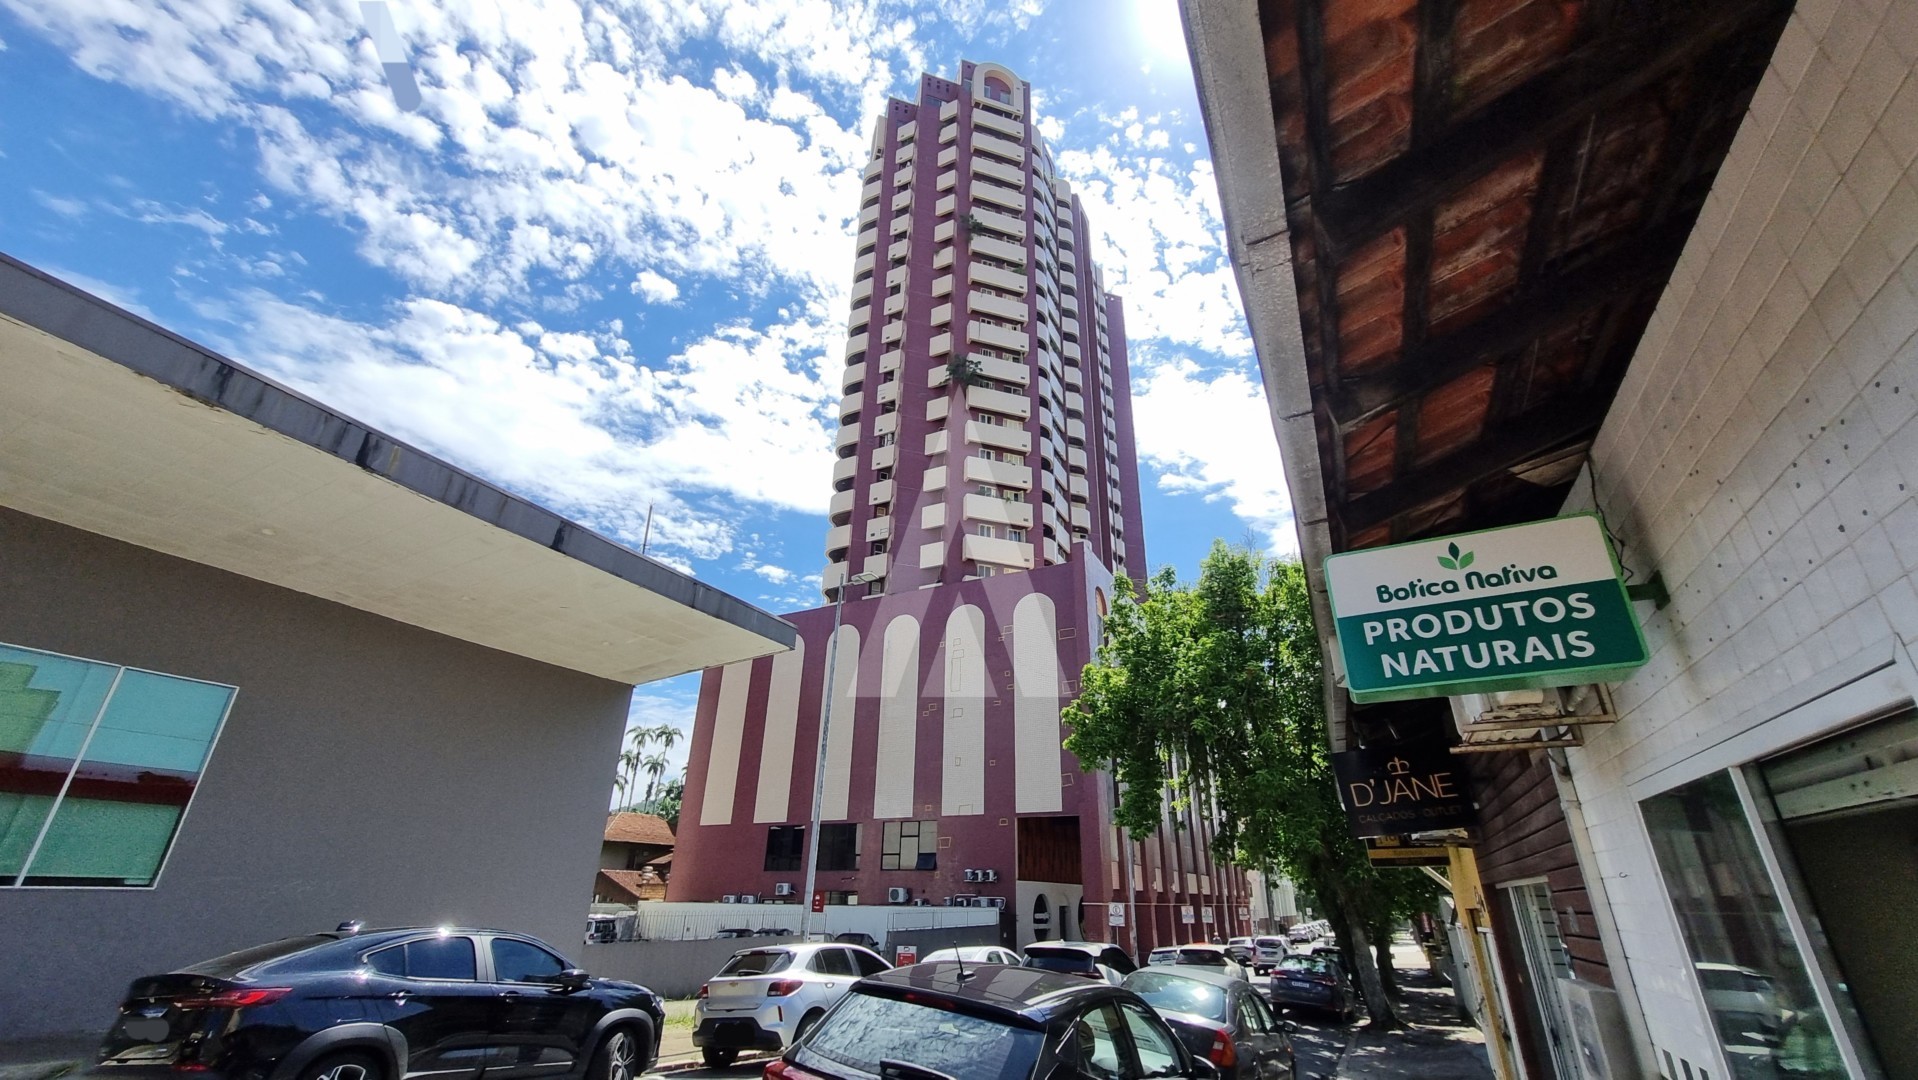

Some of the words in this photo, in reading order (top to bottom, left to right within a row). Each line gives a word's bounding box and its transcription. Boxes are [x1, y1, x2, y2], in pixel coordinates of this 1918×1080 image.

[1376, 578, 1460, 603] Botica
[1465, 564, 1558, 590] Nativa
[1363, 592, 1596, 646] PRODUTOS
[1380, 630, 1596, 679] NATURAIS
[1350, 772, 1459, 807] D'JANE
[1423, 805, 1463, 817] OUTLET
